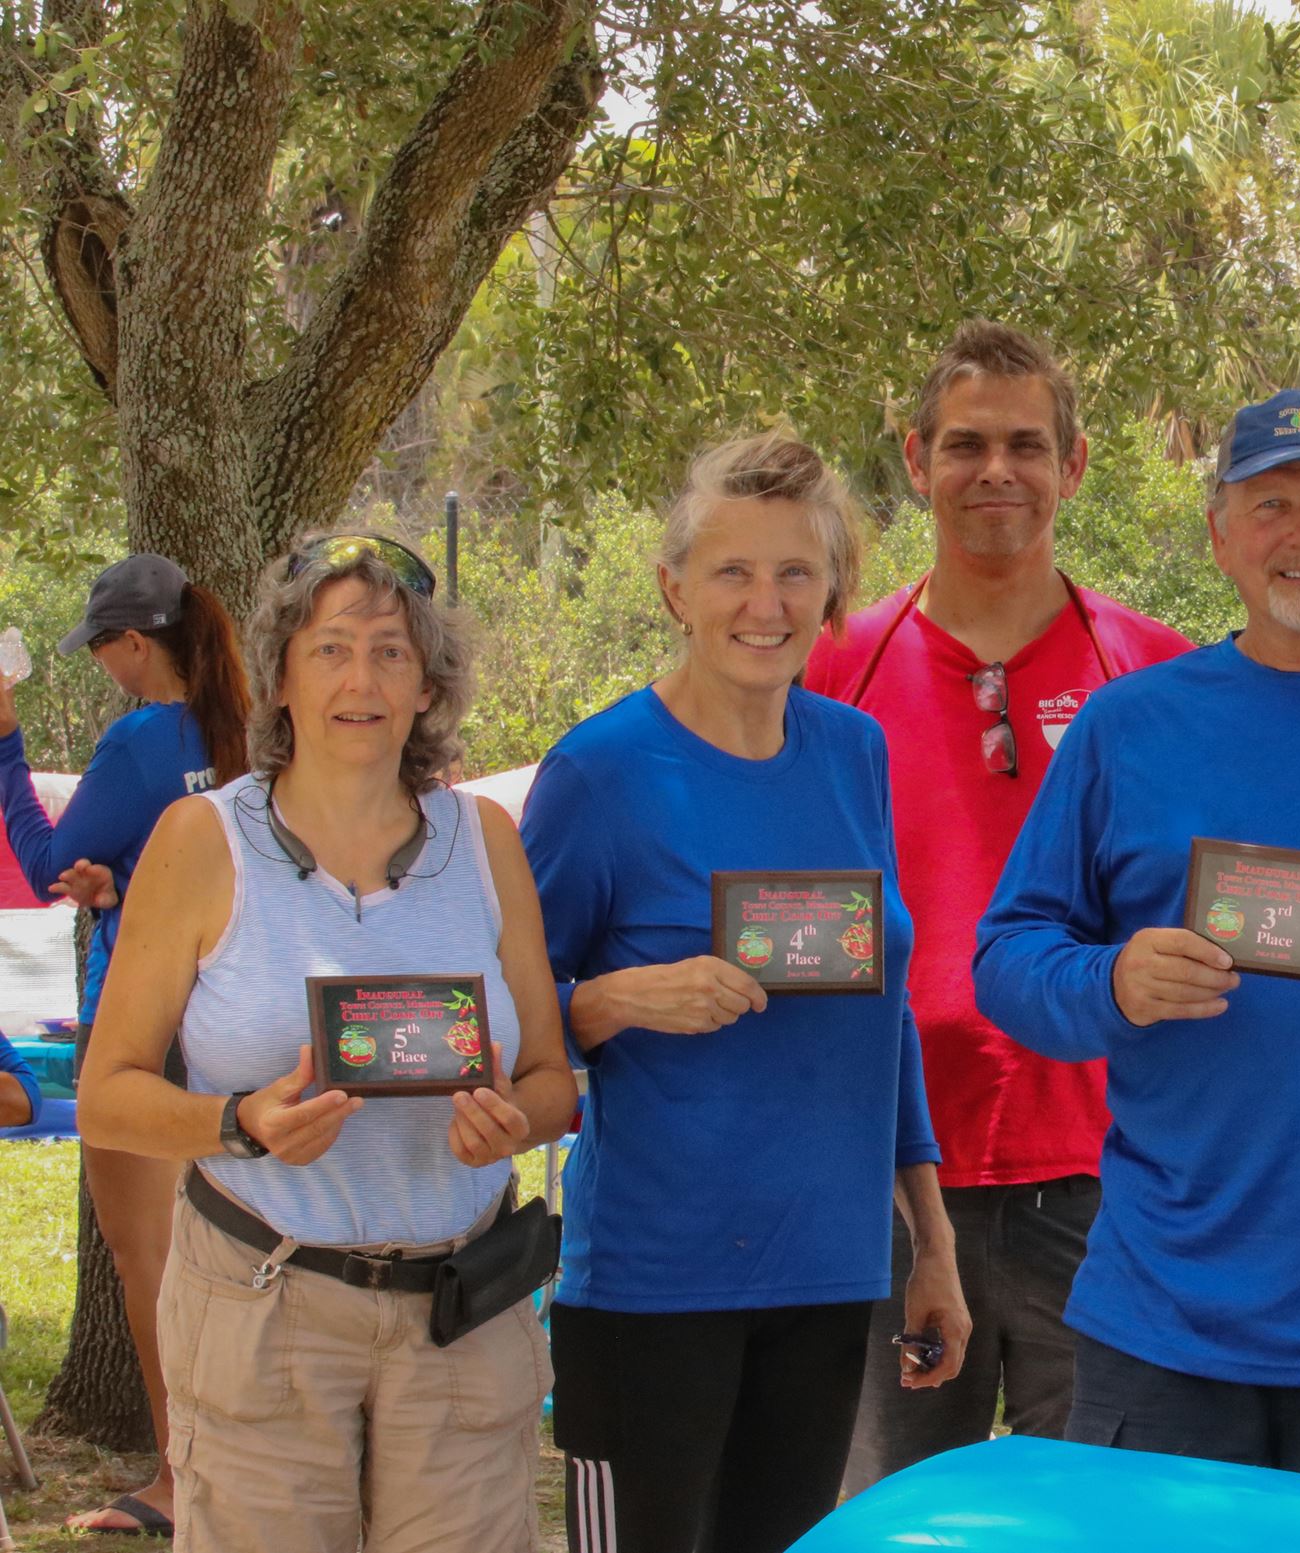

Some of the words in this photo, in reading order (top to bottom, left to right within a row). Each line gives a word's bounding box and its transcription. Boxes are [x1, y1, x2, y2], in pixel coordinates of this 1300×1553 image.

[1038, 699, 1054, 708] BIG
[1056, 697, 1079, 708] DOG
[1261, 906, 1293, 930] 3rd
[789, 924, 817, 951] 4th
[1256, 931, 1293, 948] Place
[786, 953, 821, 966] Place
[394, 1023, 421, 1049] 5th
[391, 1051, 428, 1064] Place
